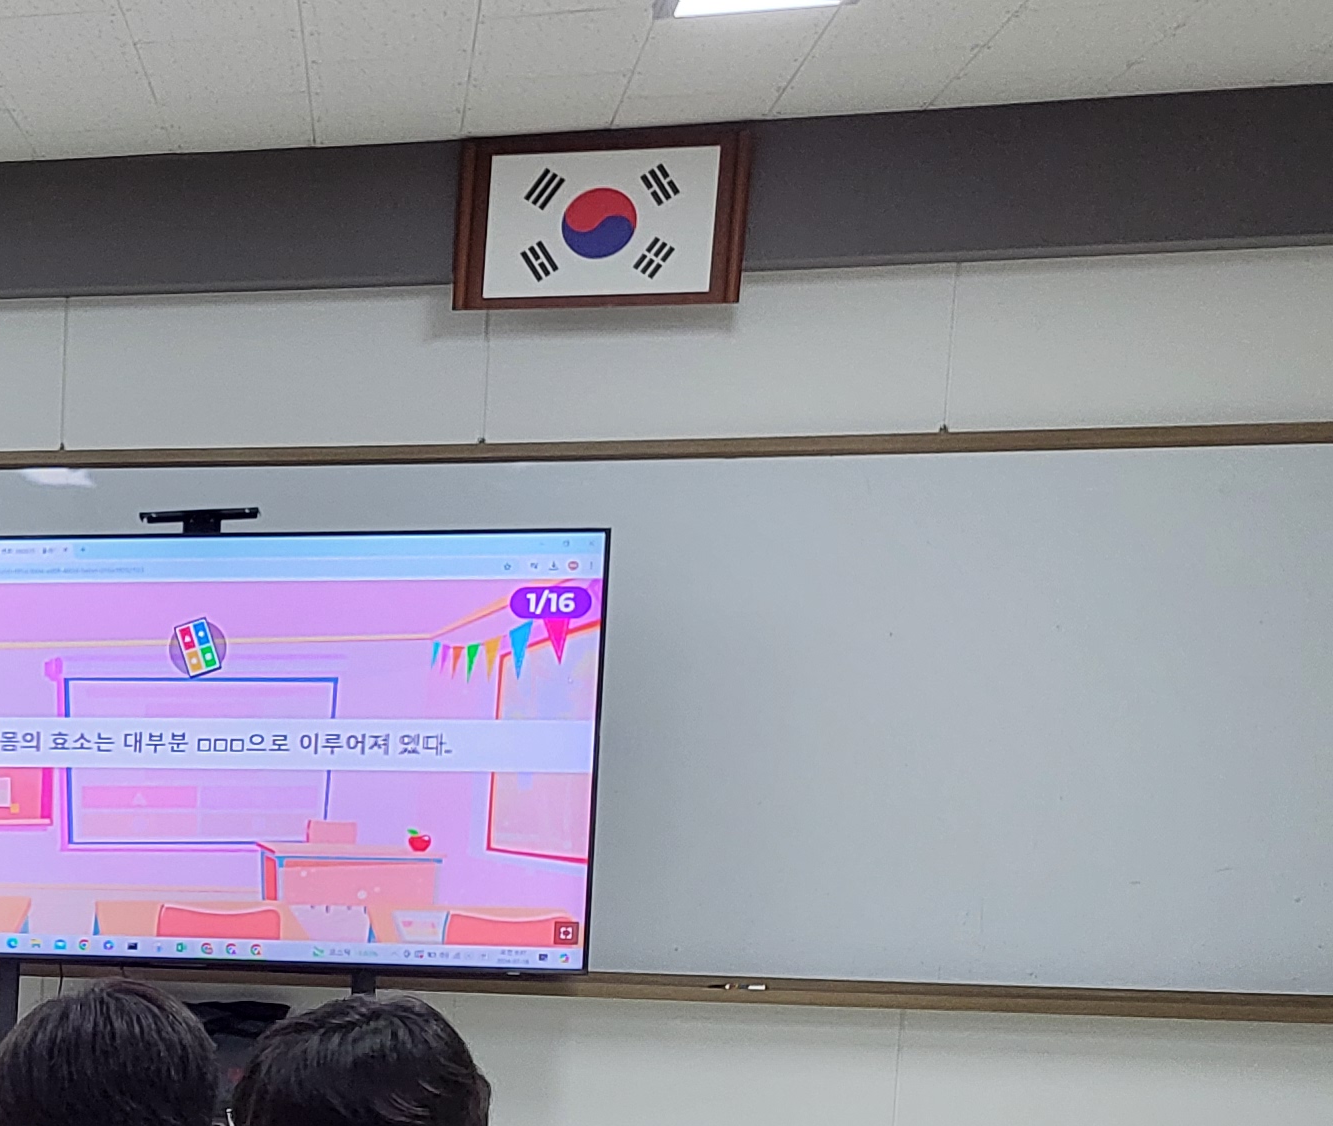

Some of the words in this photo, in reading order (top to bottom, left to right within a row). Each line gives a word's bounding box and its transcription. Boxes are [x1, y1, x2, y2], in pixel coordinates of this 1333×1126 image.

[526, 589, 575, 614] 1/16
[0, 731, 41, 752] 몸의
[49, 731, 115, 753] 효소는
[124, 731, 189, 753] 대부분
[300, 732, 390, 755] 이루어져
